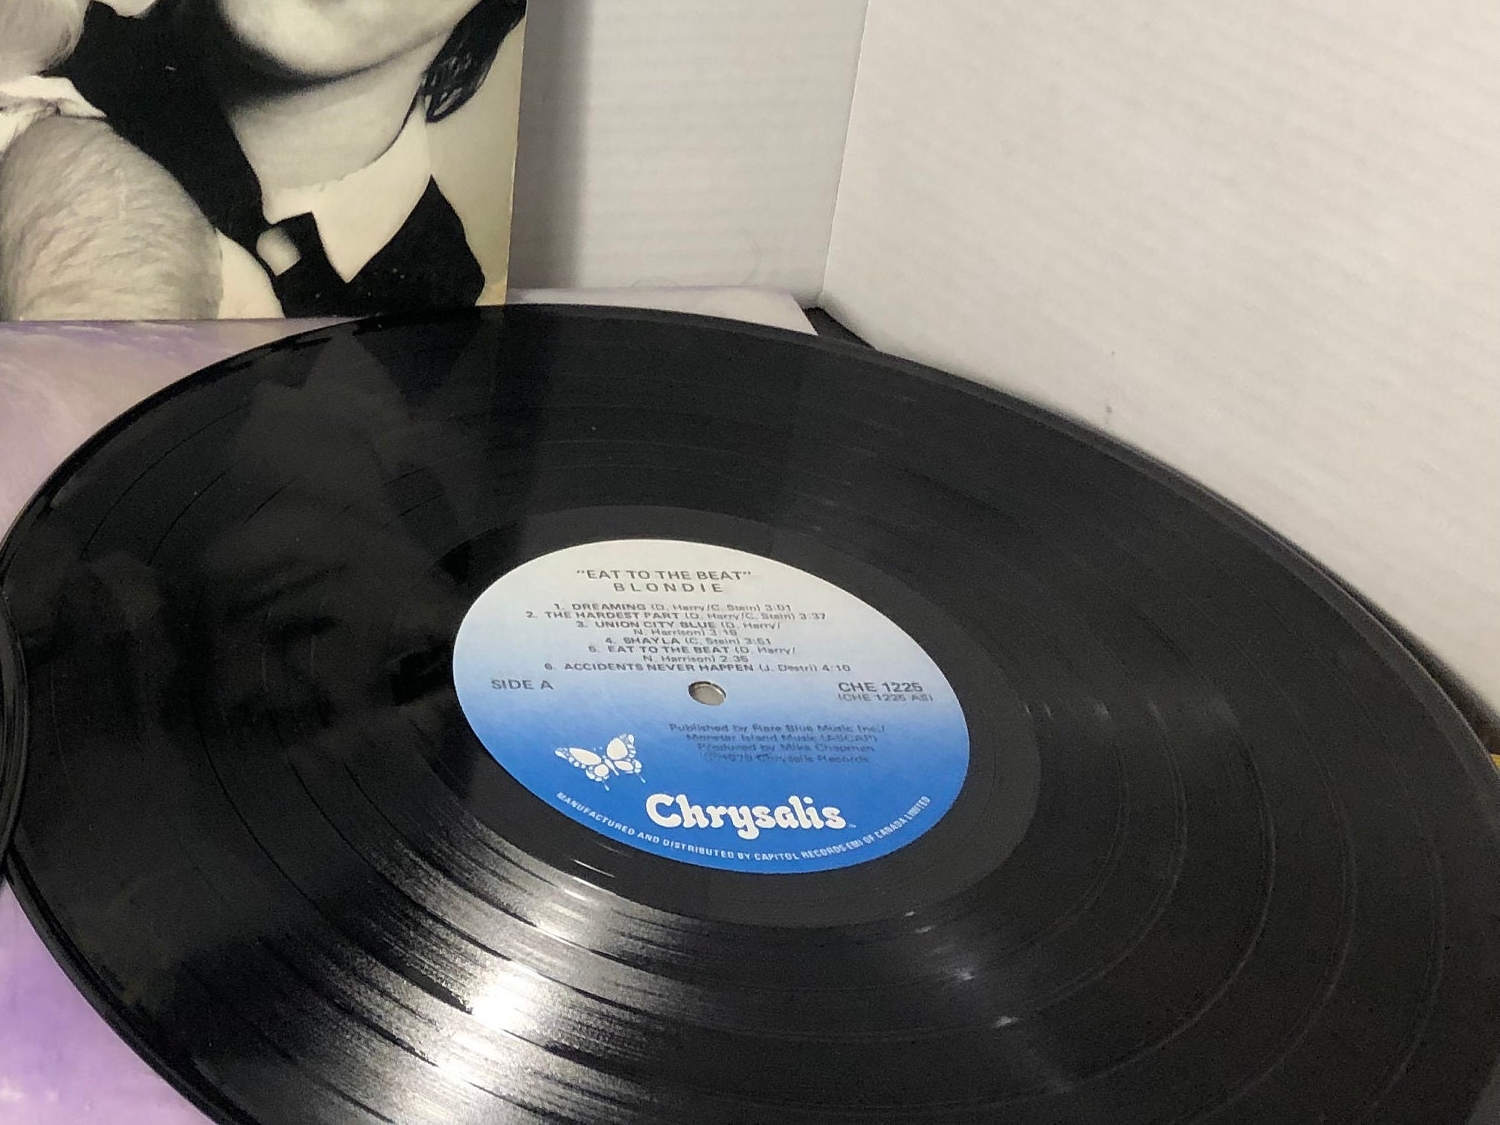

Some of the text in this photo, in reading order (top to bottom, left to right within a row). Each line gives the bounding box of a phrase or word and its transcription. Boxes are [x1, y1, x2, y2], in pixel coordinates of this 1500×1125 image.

[626, 570, 651, 579] TO
[659, 570, 690, 579] THE
[623, 637, 681, 645] SHAYLA
[564, 663, 643, 671] ACCIDENTS
[698, 664, 754, 672] HAPPEN
[491, 679, 554, 690] SIDE A
[838, 682, 923, 693] CHE 1225
[646, 793, 847, 840] Chrysalis
[556, 792, 635, 836] MANUFACTURED
[637, 832, 660, 843] AND
[662, 838, 734, 859] DISTRIBUTED
[737, 852, 750, 860] BY
[754, 852, 799, 861] CAPITOL
